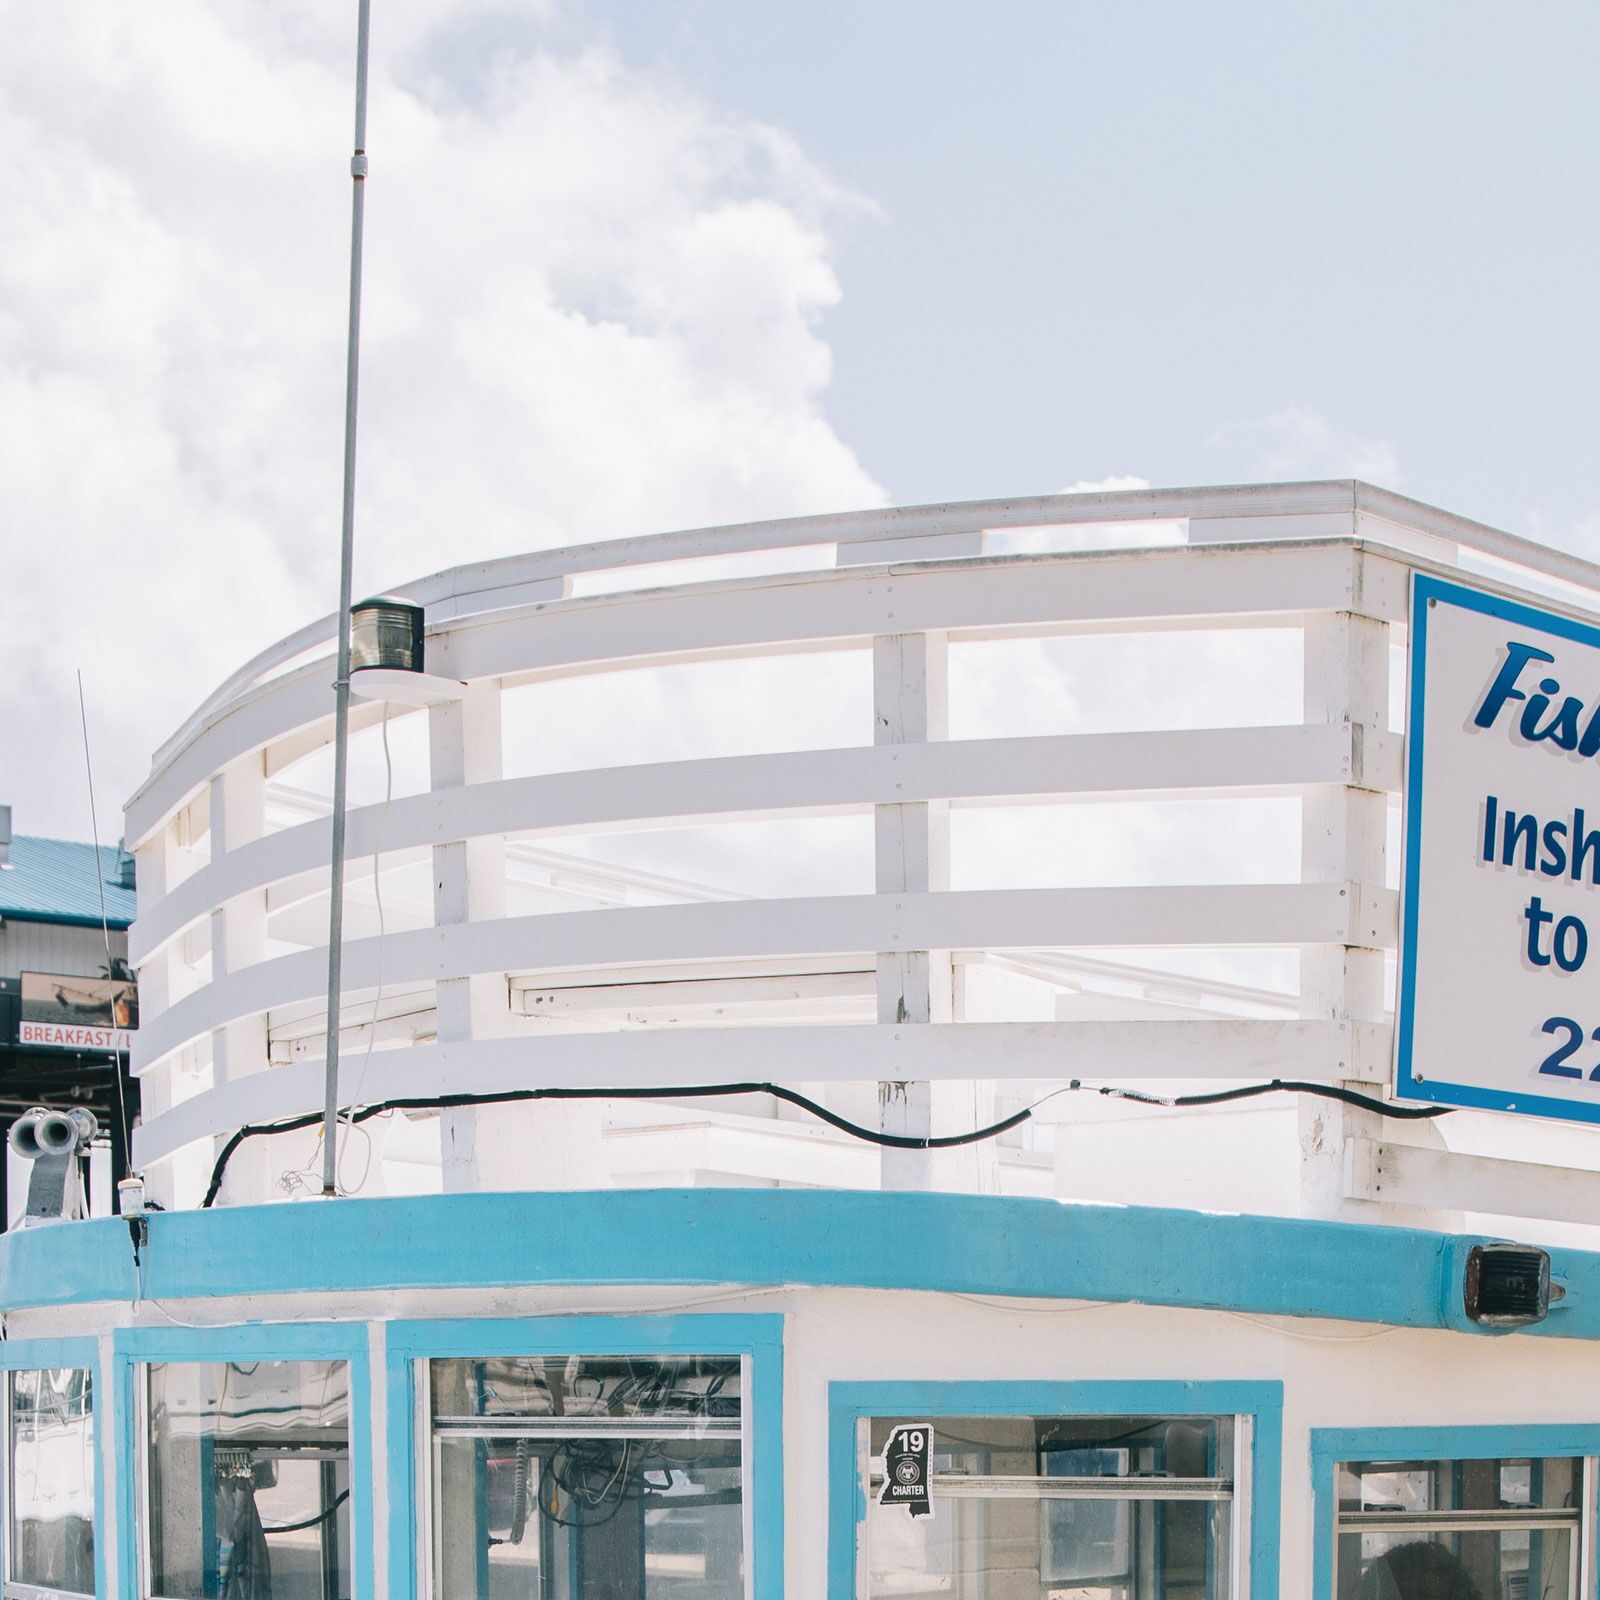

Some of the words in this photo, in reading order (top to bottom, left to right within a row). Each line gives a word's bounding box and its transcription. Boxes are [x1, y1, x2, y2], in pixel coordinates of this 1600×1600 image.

[1524, 897, 1588, 972] to
[23, 1026, 112, 1046] BREAKFAST
[898, 1431, 924, 1452] 19
[892, 1485, 925, 1496] CHARTER
